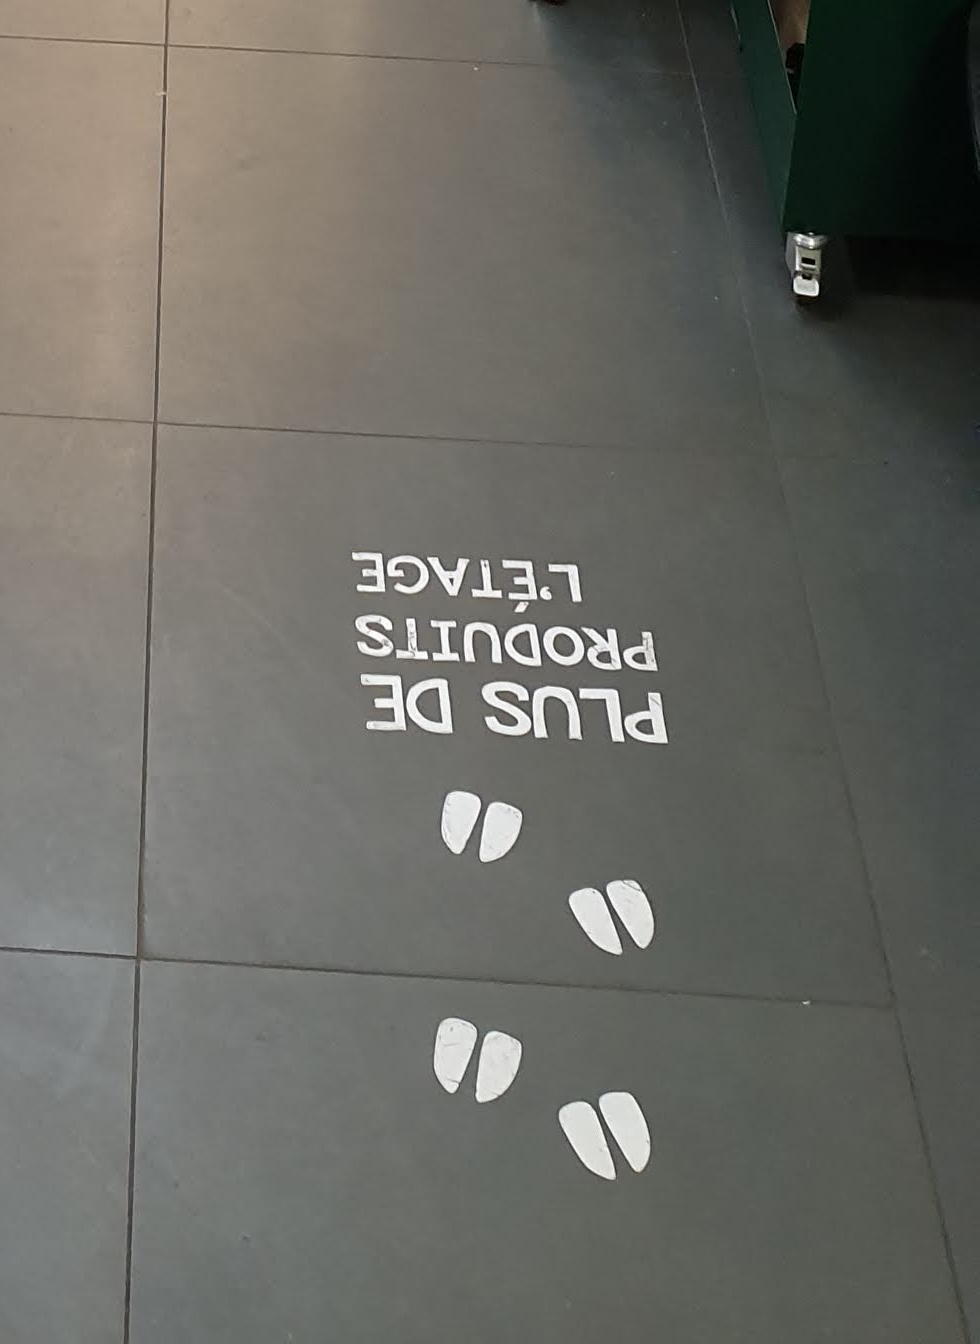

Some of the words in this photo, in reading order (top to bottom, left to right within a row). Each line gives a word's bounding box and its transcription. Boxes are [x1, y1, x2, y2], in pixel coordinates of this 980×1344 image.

[351, 551, 582, 613] L'ÉTAGE
[354, 614, 659, 672] PRODUITS
[359, 673, 454, 734] DE
[481, 681, 669, 744] PLUS
